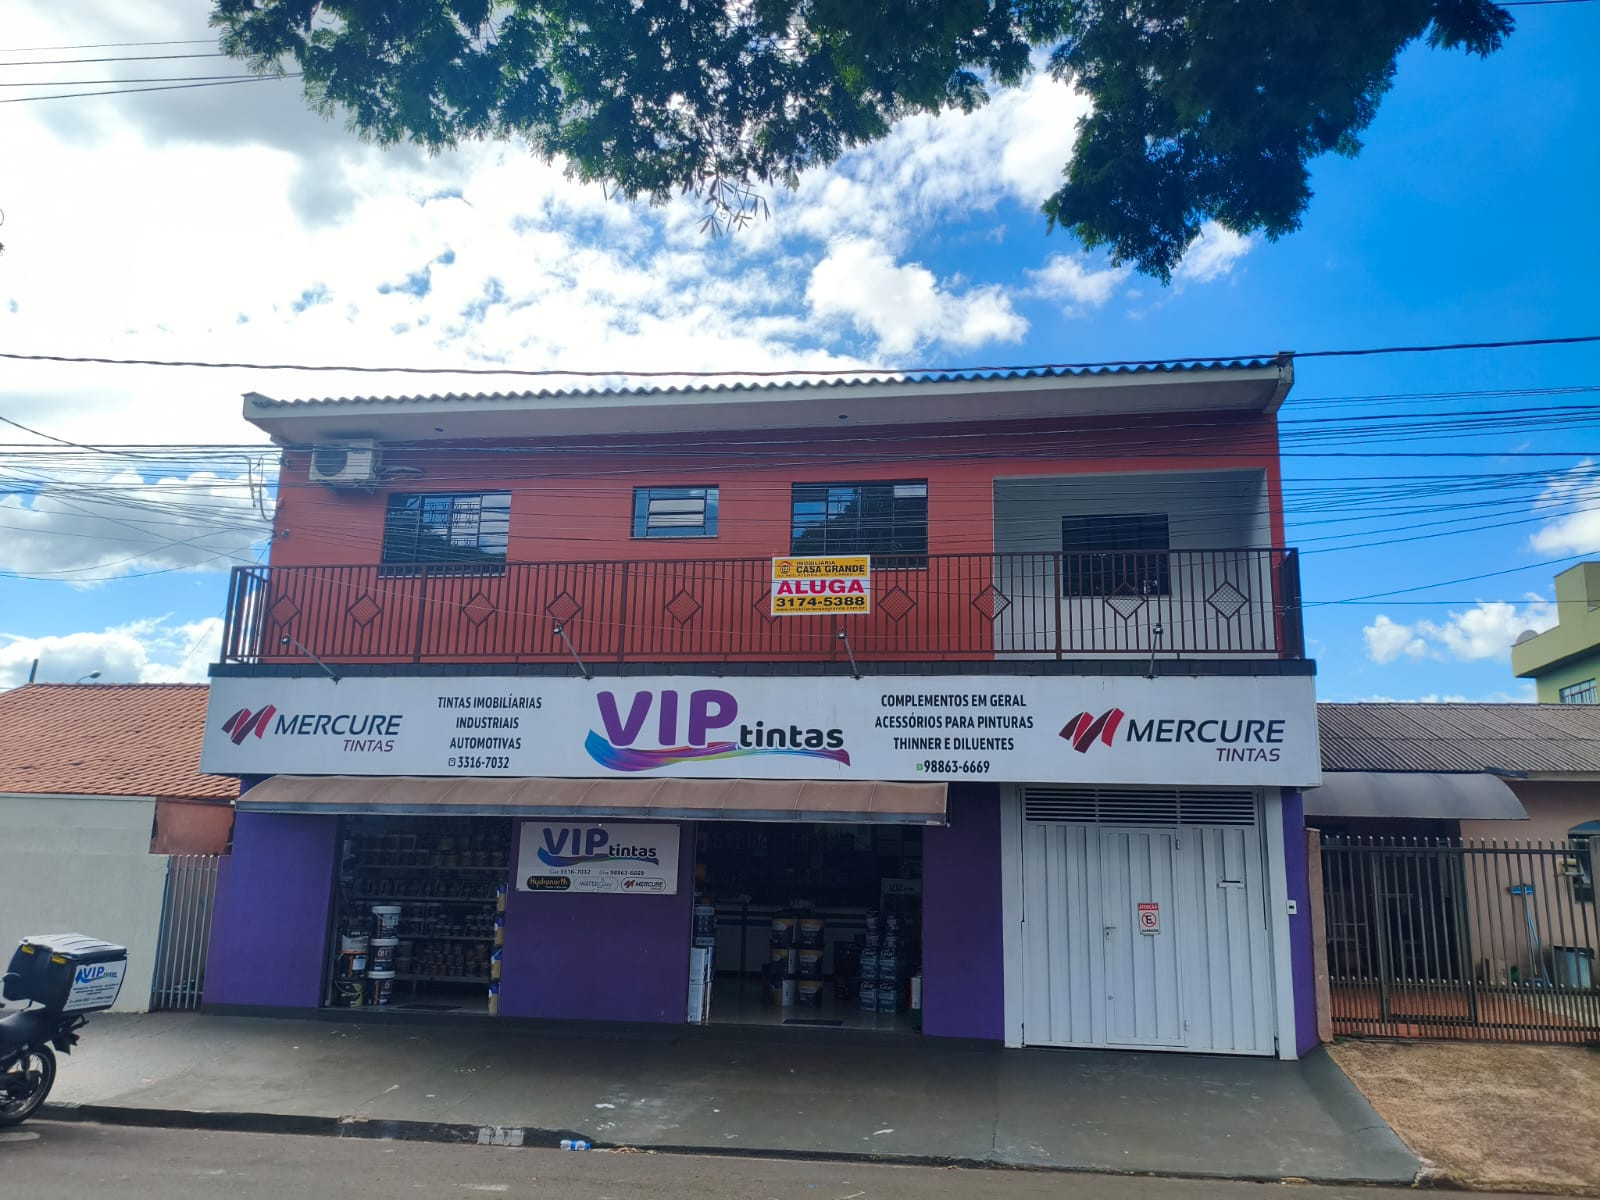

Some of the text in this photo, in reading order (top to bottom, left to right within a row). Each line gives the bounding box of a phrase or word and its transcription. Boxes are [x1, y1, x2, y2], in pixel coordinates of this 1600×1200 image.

[796, 564, 865, 574] CASA GRANDE
[777, 579, 865, 595] ALUGA
[776, 596, 865, 607] 3174-5388
[438, 696, 471, 709] TINTAS
[881, 694, 1026, 707] COMPLEMENTOS EM GERAL
[274, 714, 403, 736] MERCURE
[456, 716, 519, 729] INDUSTRIAIS
[596, 689, 844, 749] VIP tintas
[875, 712, 1034, 728] ACESSÓRIOS PARA PINTURAS
[1126, 719, 1286, 743] MERCURE
[343, 739, 395, 752] TINTAS
[449, 737, 521, 749] AUTOMOTIVAS
[893, 737, 1015, 750] THINNER E DILUENTES
[1216, 748, 1281, 762] TINTAS
[457, 756, 510, 769] 3316-7032
[924, 760, 990, 773] 98863-6669
[543, 828, 657, 857] VIP tintas
[84, 966, 105, 979] VIP
